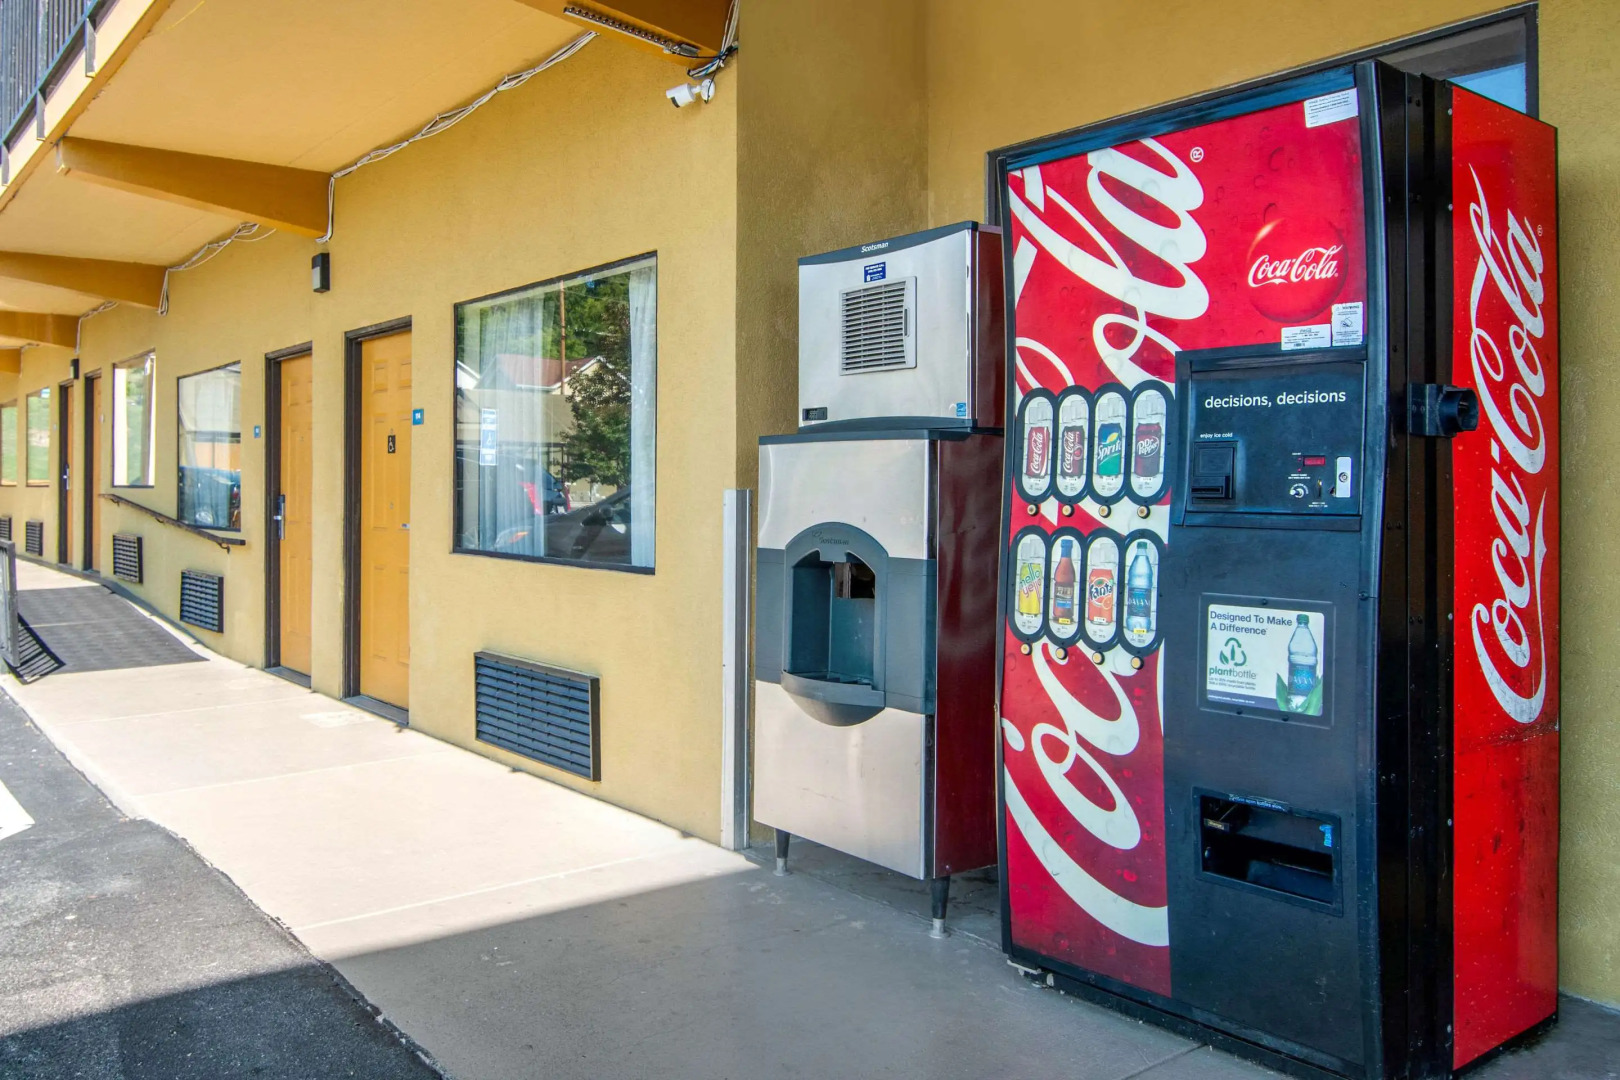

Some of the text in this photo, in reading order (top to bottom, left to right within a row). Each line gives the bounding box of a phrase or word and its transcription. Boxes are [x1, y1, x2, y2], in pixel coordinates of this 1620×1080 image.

[861, 241, 889, 253] Scotsman
[1247, 244, 1343, 288] Coca-Cola
[1204, 390, 1347, 409] decisions, decisions
[1098, 441, 1122, 460] Sprite
[1138, 441, 1158, 455] Pepper
[1144, 438, 1154, 448] Dr
[1468, 163, 1546, 724] Coca-Cola
[1030, 431, 1044, 474] Coca-Cola
[1089, 580, 1113, 601] fanta
[1210, 611, 1293, 627] Designed To Make
[1210, 622, 1267, 636] A Difference
[1209, 666, 1257, 680] plantbottle
